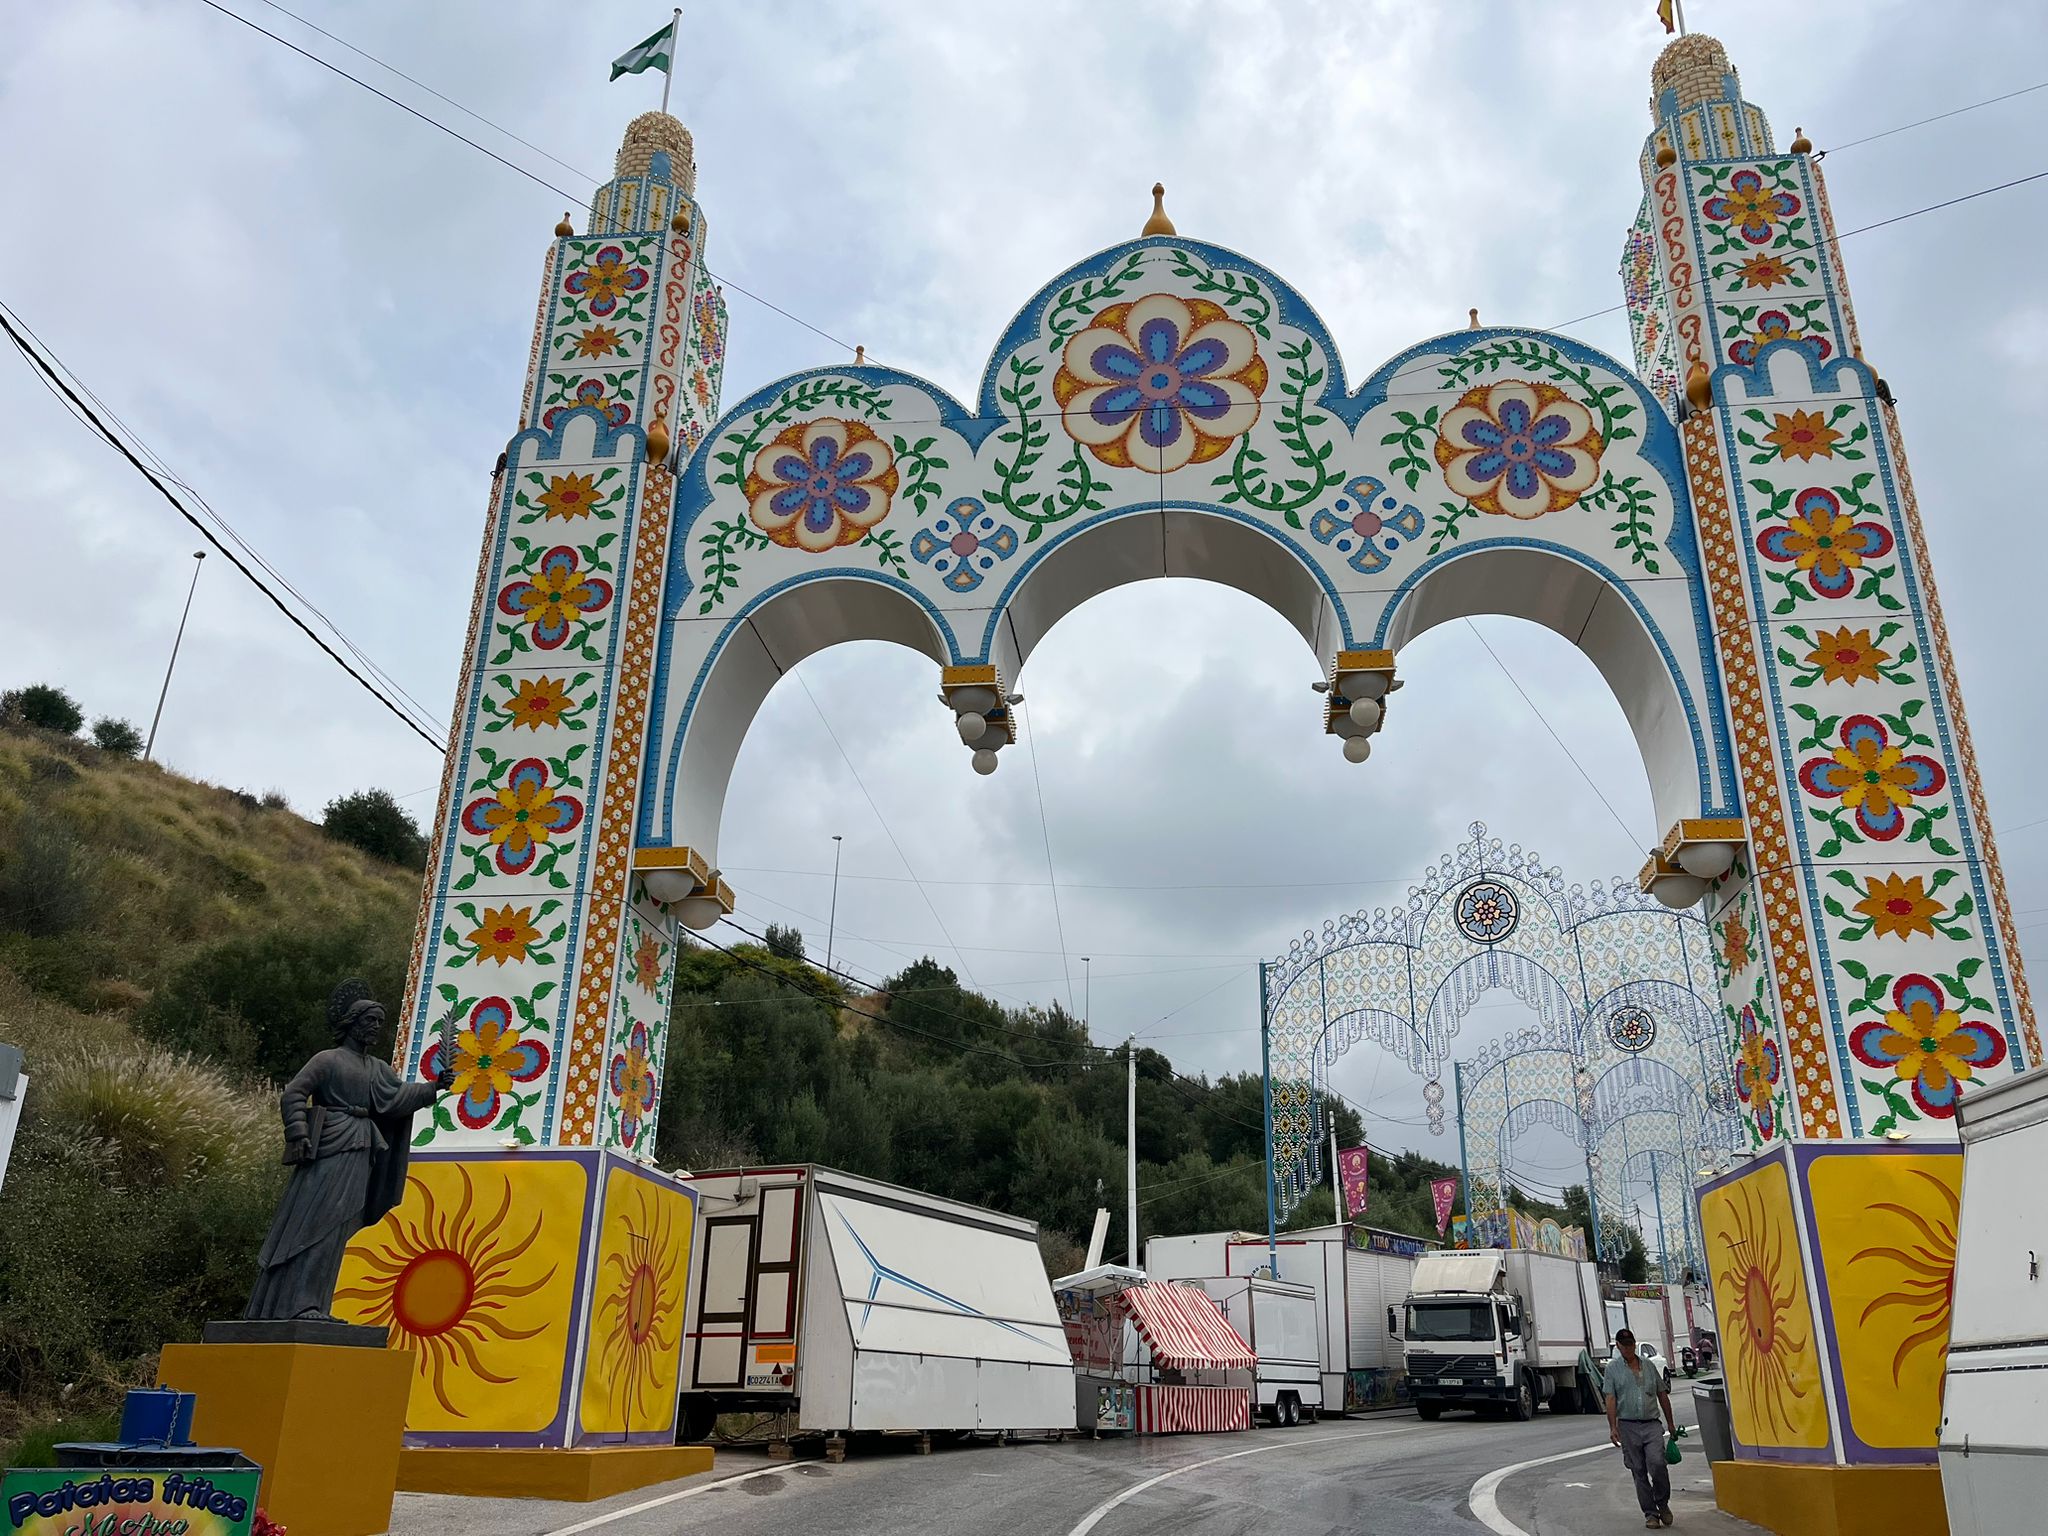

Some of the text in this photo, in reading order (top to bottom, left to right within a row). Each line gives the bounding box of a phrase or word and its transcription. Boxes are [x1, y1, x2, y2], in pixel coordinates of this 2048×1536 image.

[1372, 1235, 1390, 1249] TIRO
[9, 1473, 248, 1528] Patatas fritas
[64, 1512, 117, 1536] Mi
